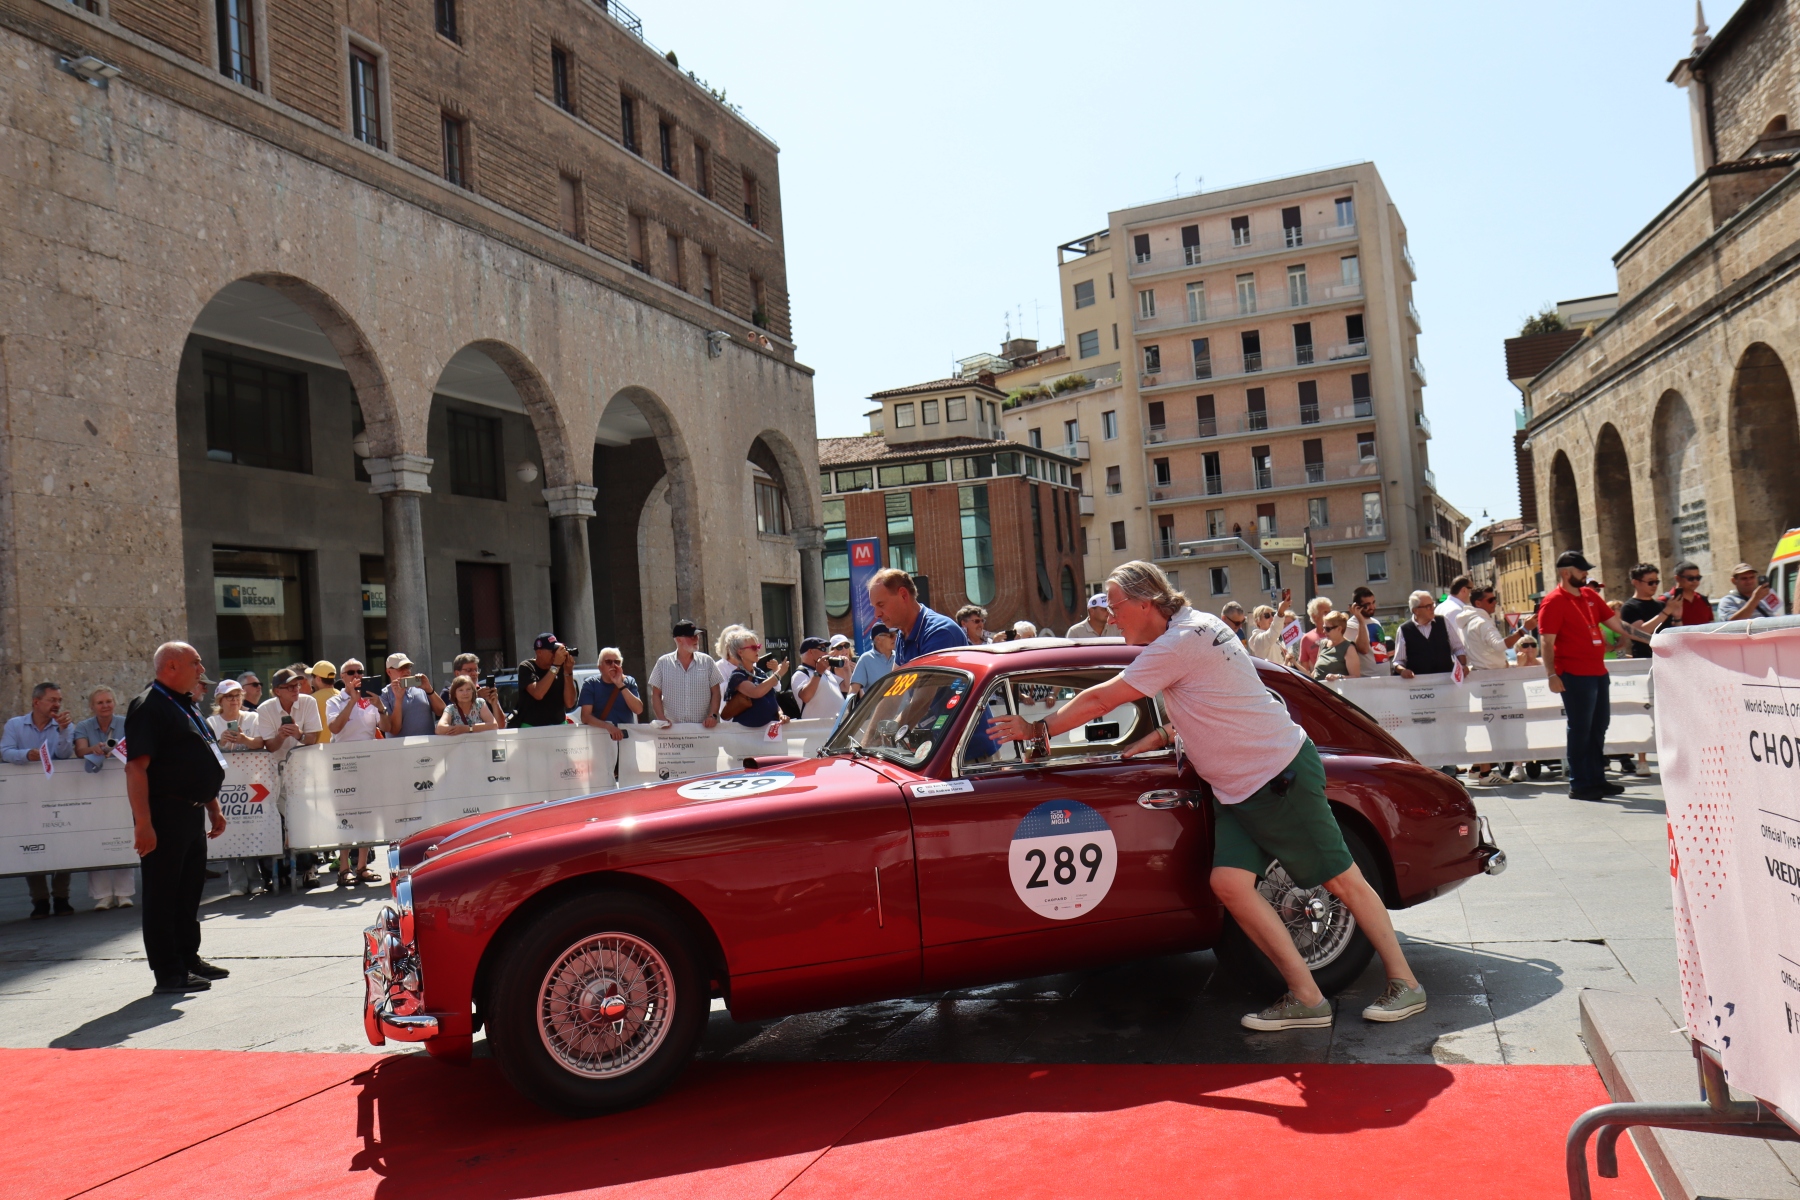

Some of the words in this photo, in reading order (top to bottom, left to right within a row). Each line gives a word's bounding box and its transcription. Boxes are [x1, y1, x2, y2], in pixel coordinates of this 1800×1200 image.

[855, 546, 871, 559] M
[242, 587, 257, 596] BCC
[371, 592, 383, 600] BCC
[242, 596, 276, 605] BRESCIA
[372, 600, 386, 608] BRES
[884, 674, 918, 696] 289
[1744, 699, 1762, 712] World
[1763, 700, 1784, 717] Sponsor
[689, 778, 776, 790] 289
[220, 792, 248, 804] 000
[1761, 824, 1782, 843] Official
[1782, 831, 1796, 849] Tyre
[1024, 842, 1102, 889] 289
